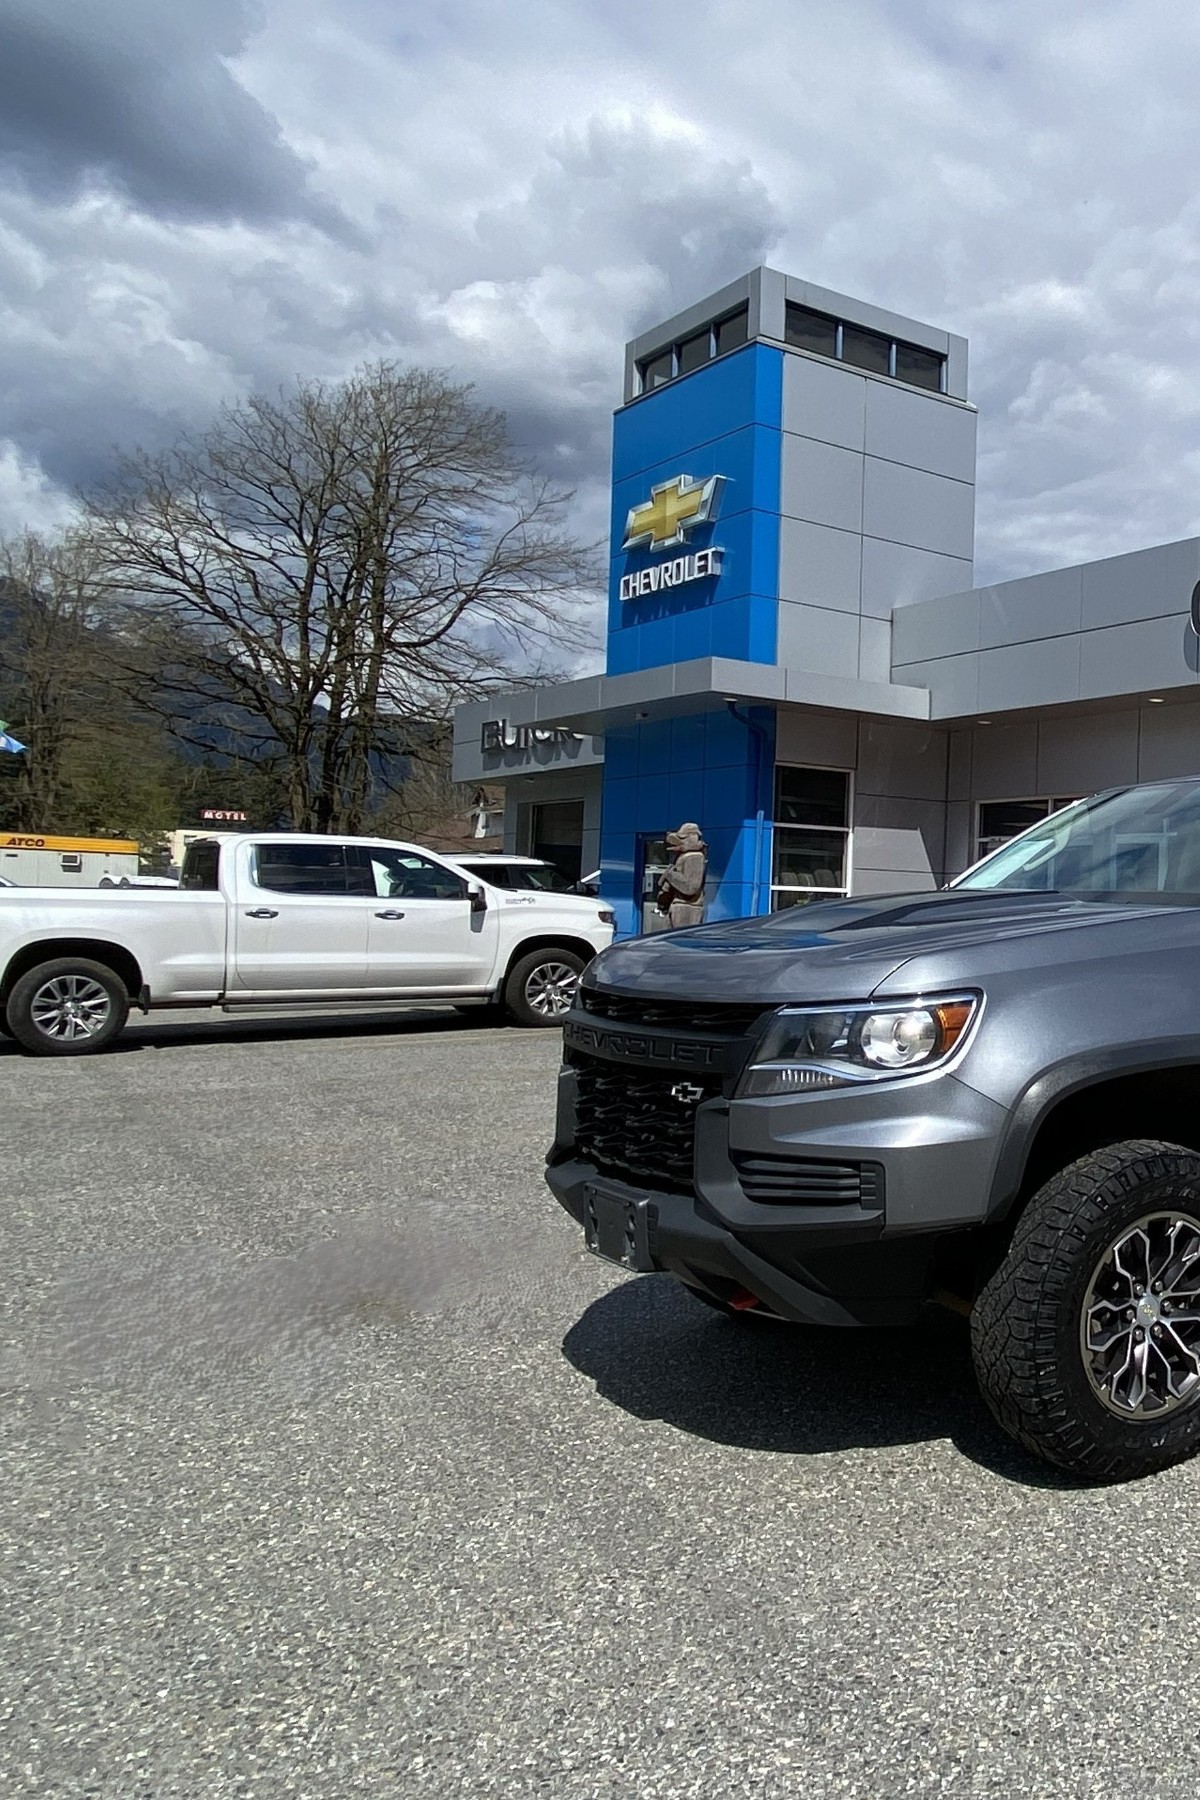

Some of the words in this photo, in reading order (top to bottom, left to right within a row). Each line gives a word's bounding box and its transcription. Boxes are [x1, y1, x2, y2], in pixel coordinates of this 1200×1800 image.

[619, 547, 723, 601] CHEVROLET
[203, 810, 247, 821] MOTEL
[6, 837, 45, 847] ATCO
